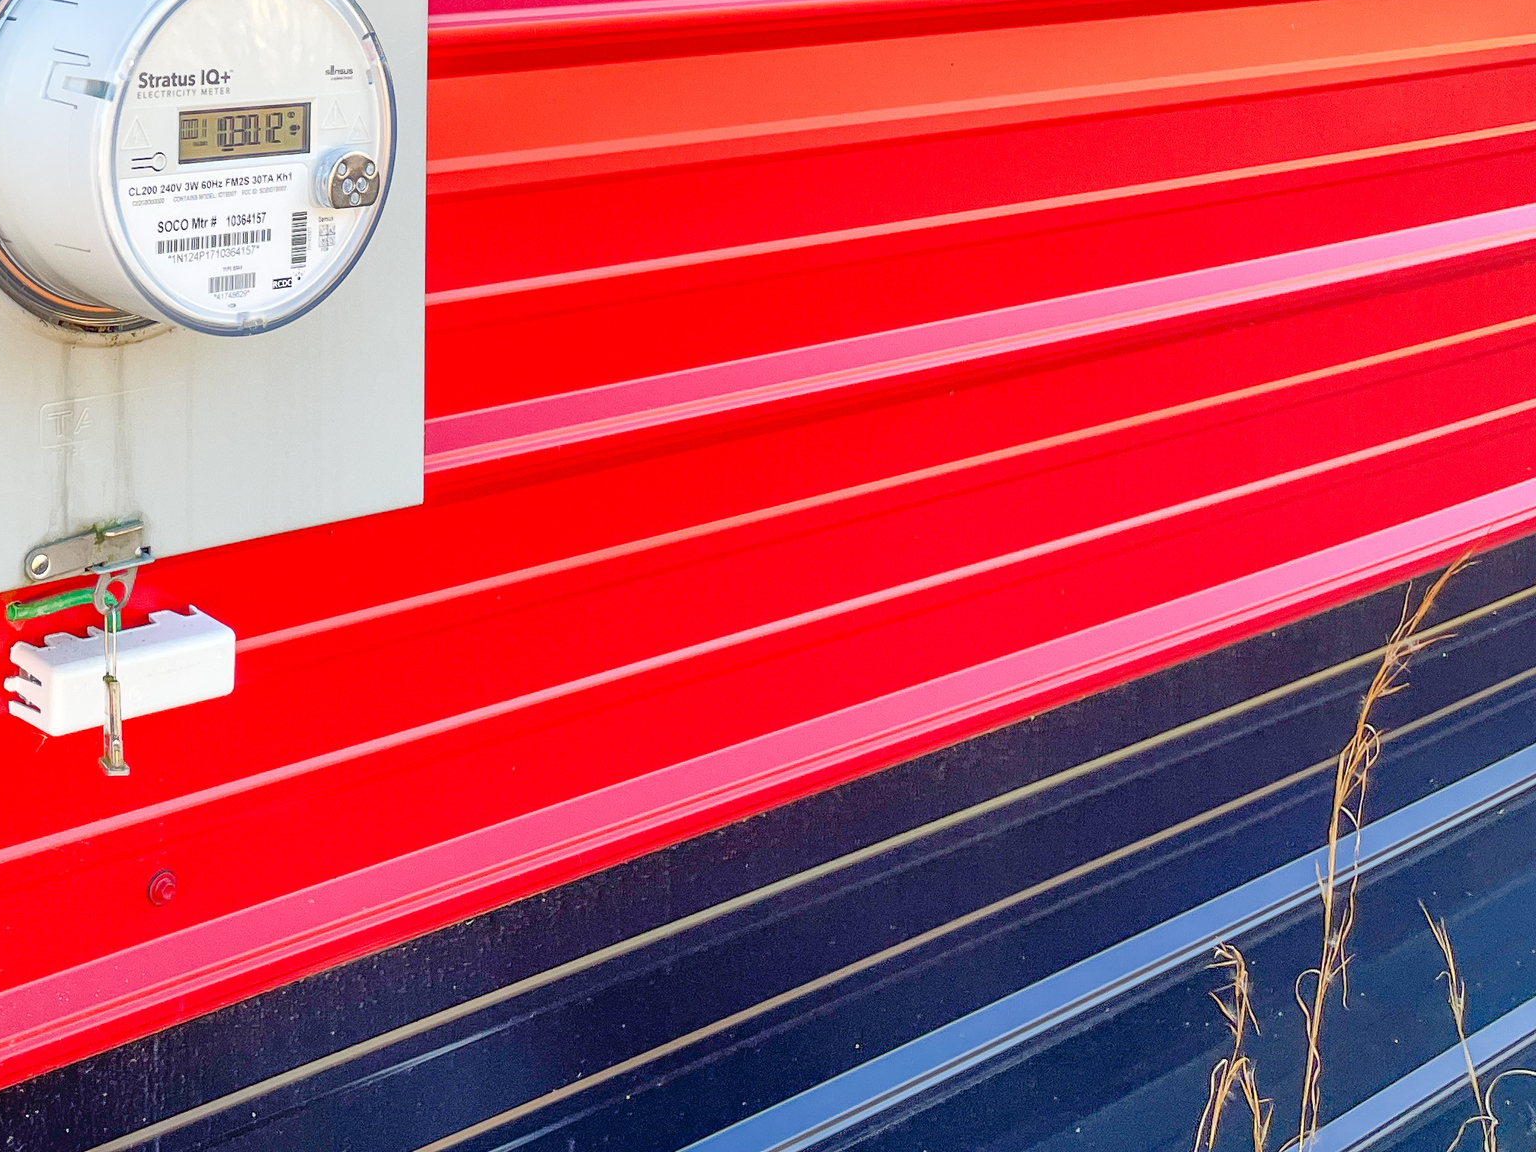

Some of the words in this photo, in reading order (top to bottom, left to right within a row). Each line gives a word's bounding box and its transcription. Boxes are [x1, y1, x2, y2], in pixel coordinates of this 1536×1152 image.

[138, 71, 196, 89] Stratus
[137, 88, 197, 100] ELECTRICITY
[201, 86, 231, 96] METER
[128, 185, 158, 197] CL200
[160, 182, 183, 194] 240V
[184, 181, 200, 191] 3W
[201, 179, 223, 190] 60Hz
[225, 176, 250, 187] FM2S
[252, 174, 274, 185] 30TA
[276, 172, 293, 182] Kh1
[157, 218, 189, 233] SOCO
[191, 217, 209, 229] Mtr
[210, 215, 217, 227] #
[226, 211, 267, 227] 10364157
